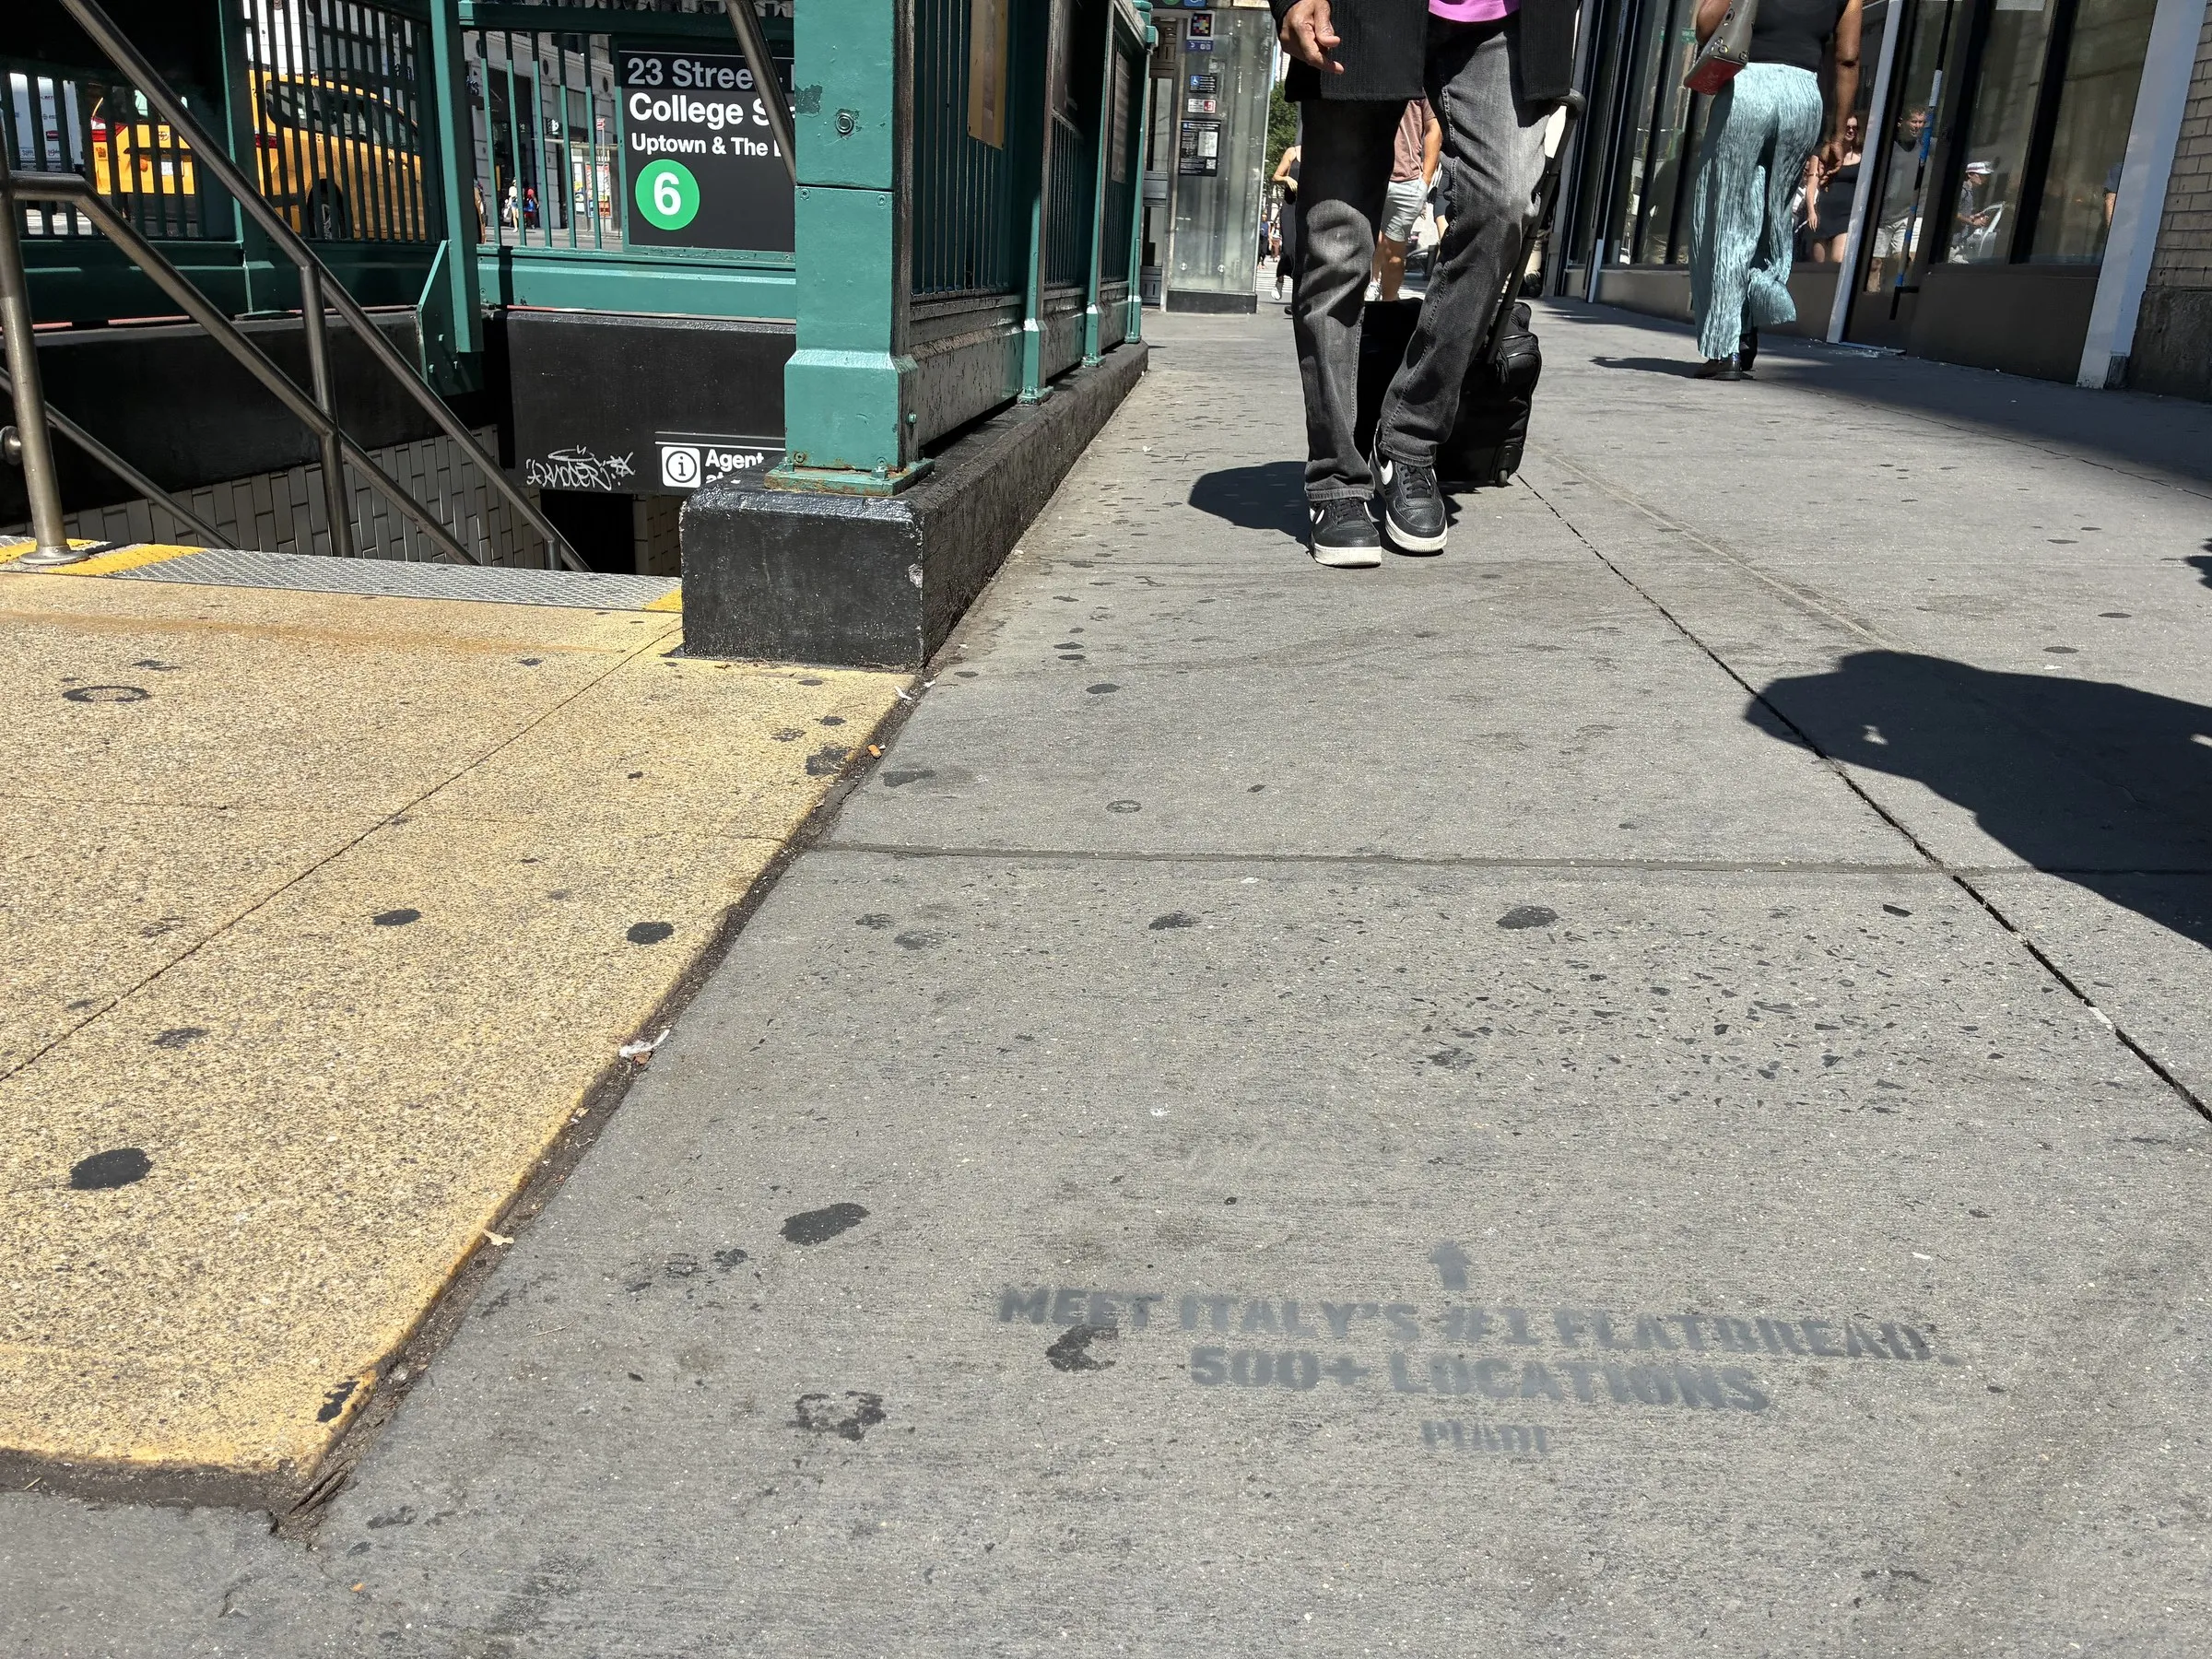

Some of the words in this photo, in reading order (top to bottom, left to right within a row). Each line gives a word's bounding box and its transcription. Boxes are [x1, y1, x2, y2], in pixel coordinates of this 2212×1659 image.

[627, 57, 664, 86] 23
[672, 59, 753, 89] Stree
[629, 92, 744, 131] College
[631, 132, 707, 156] Uptown
[712, 135, 727, 156] &
[731, 137, 769, 158] The
[653, 171, 682, 216] 6
[999, 1287, 1163, 1328] MEET
[1180, 1295, 1421, 1342] ITALY'S
[1190, 1346, 1371, 1390] 500+
[1388, 1353, 1771, 1412] LOCATIONS
